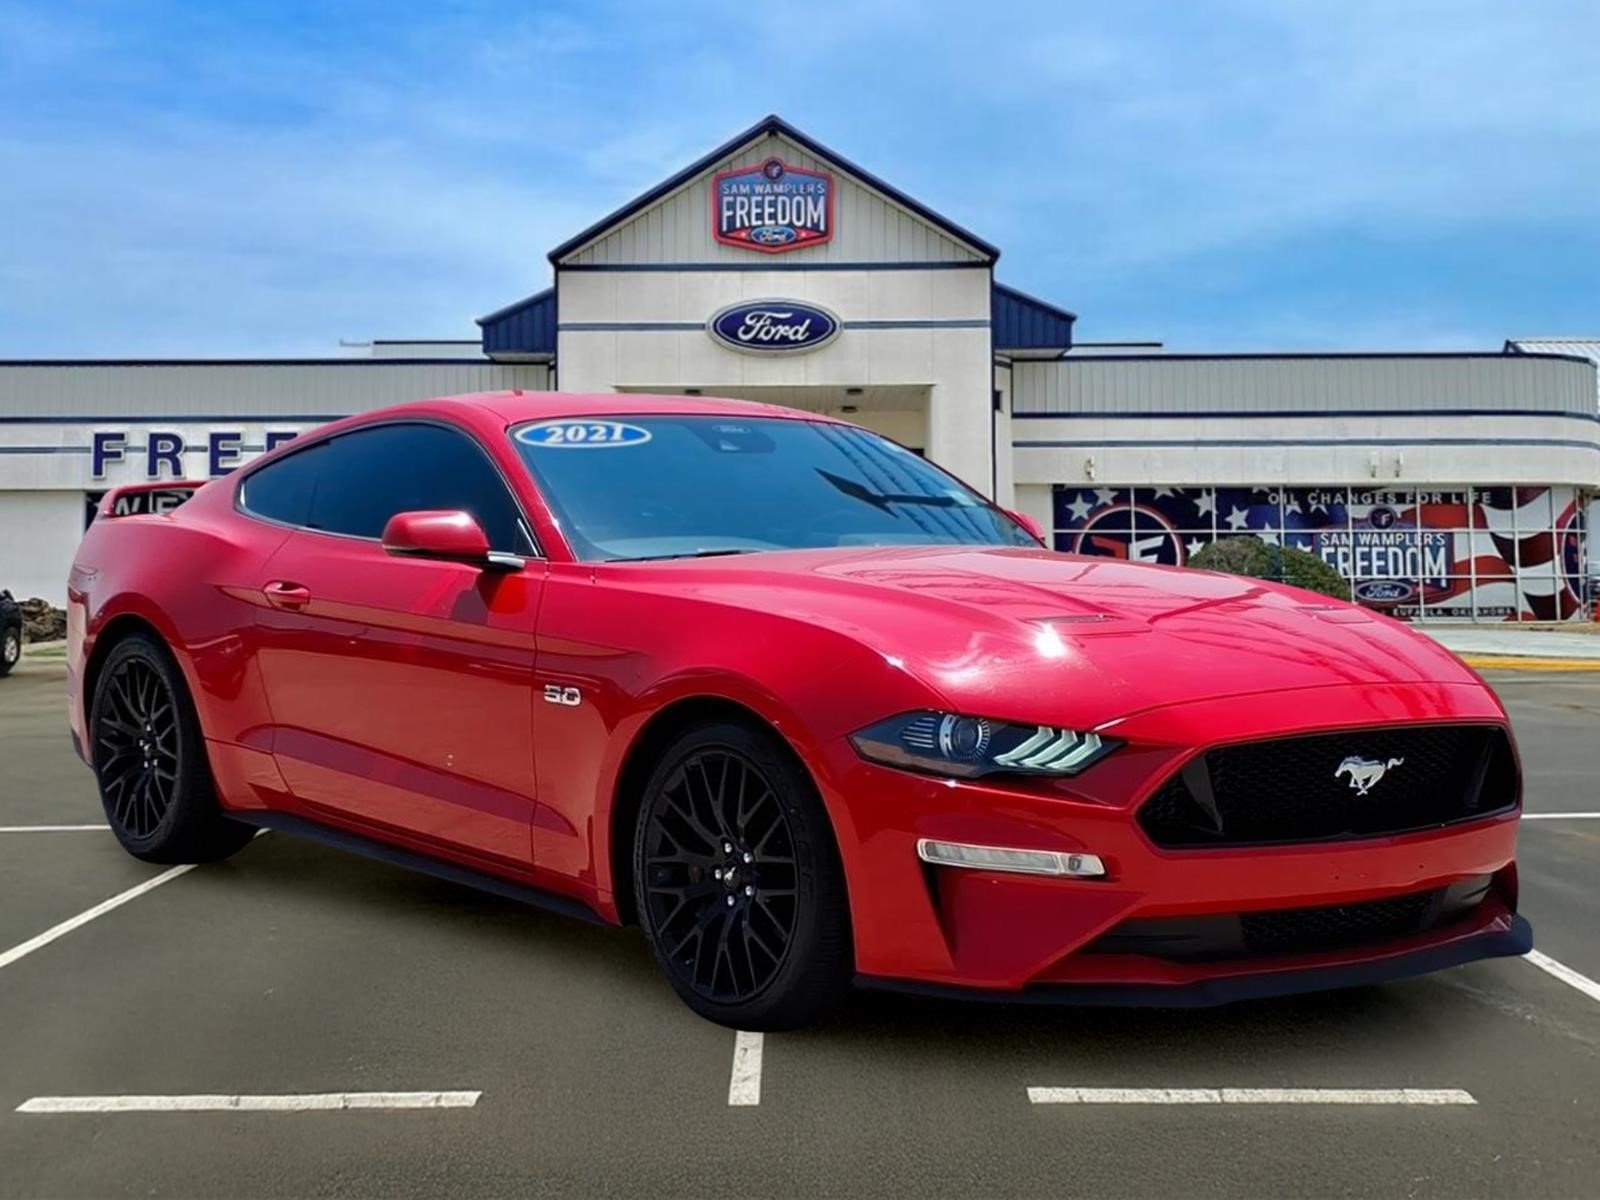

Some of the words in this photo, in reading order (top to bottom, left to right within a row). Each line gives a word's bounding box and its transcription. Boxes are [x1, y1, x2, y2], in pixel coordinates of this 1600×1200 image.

[722, 183, 750, 194] SAM
[722, 195, 825, 232] FREEDOM
[737, 311, 811, 341] Ford
[544, 424, 625, 444] 2021
[1268, 492, 1298, 505] OIL
[1307, 492, 1397, 505] CHANGES
[1405, 492, 1443, 505] FOR
[1451, 491, 1491, 504] LIFE
[1321, 546, 1447, 588] FREEDOM
[1365, 584, 1400, 598] Ford
